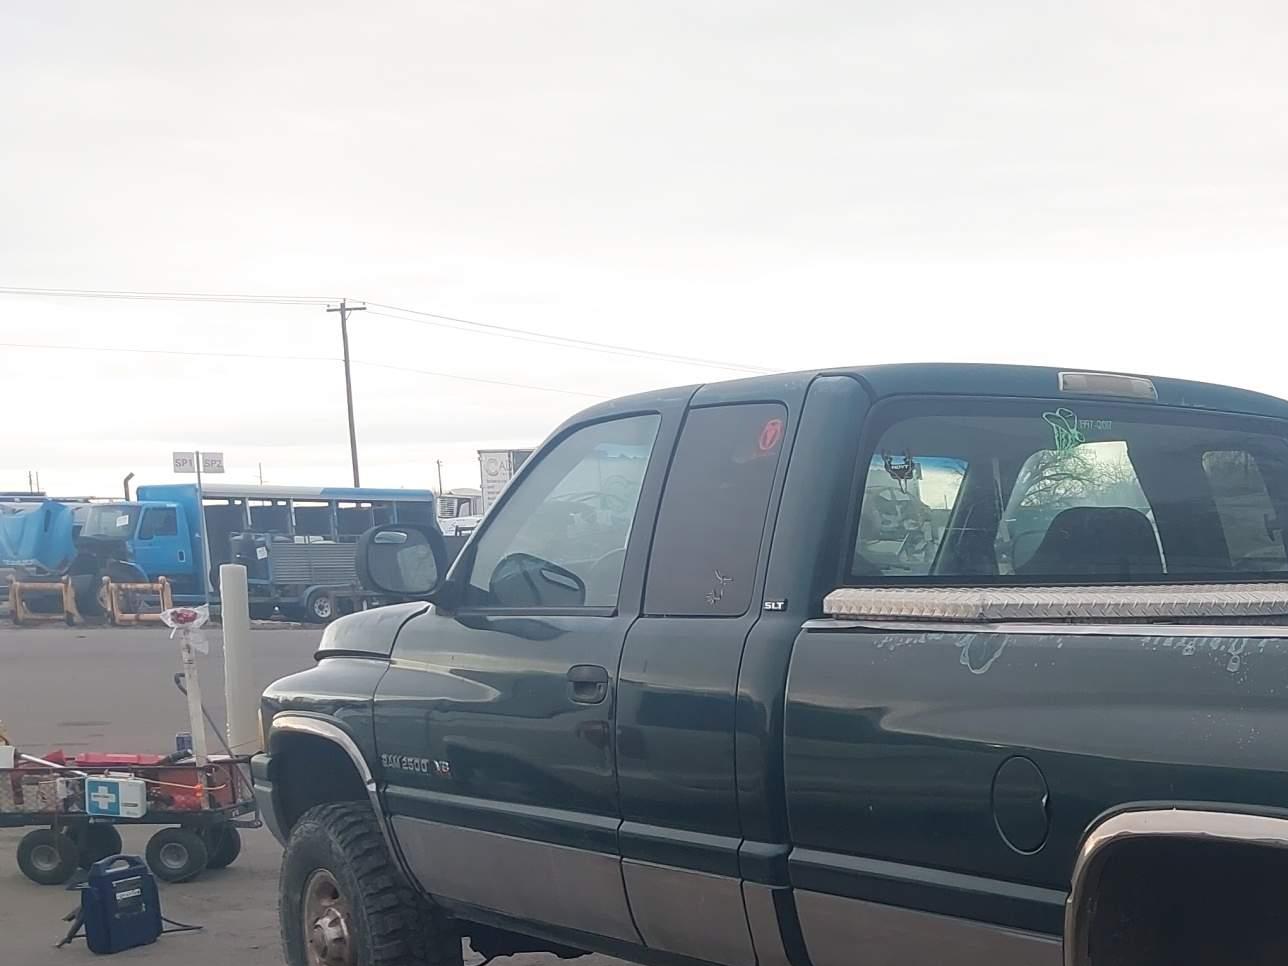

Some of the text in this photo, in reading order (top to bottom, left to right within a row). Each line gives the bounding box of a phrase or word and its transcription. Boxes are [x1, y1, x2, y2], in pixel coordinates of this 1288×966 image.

[175, 458, 193, 467] SP1
[204, 459, 223, 468] SP2
[764, 601, 785, 610] SLT
[401, 756, 429, 772] 2500
